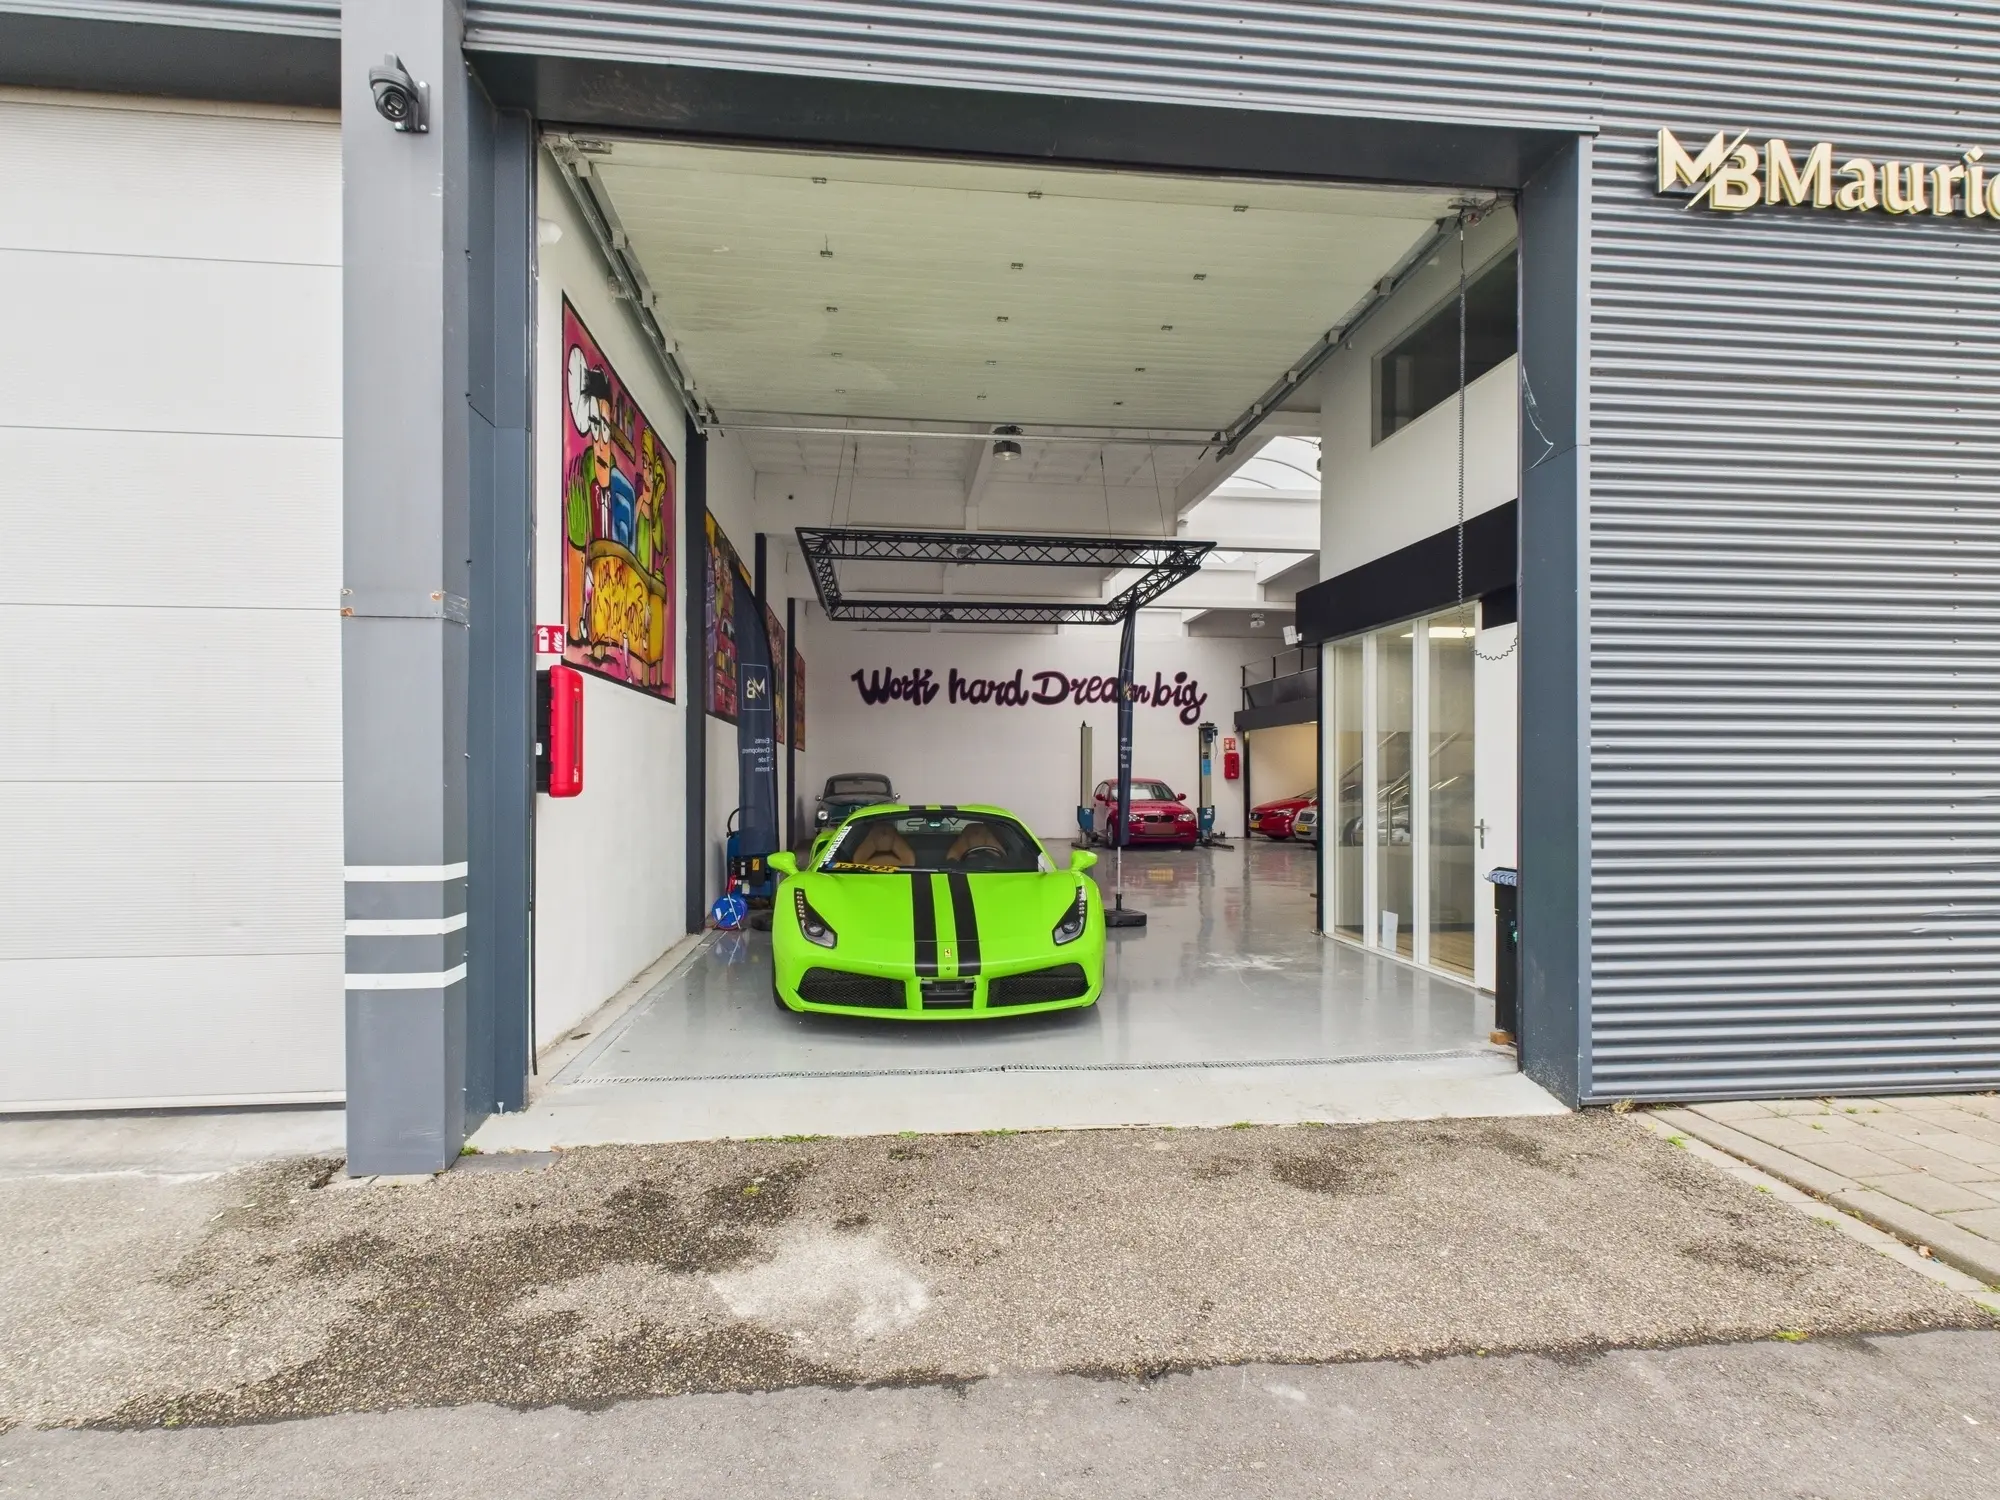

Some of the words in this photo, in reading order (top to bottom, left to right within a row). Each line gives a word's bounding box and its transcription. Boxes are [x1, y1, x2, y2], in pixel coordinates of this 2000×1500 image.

[851, 667, 939, 706] Work
[948, 668, 1030, 706] hard
[1151, 672, 1208, 725] big
